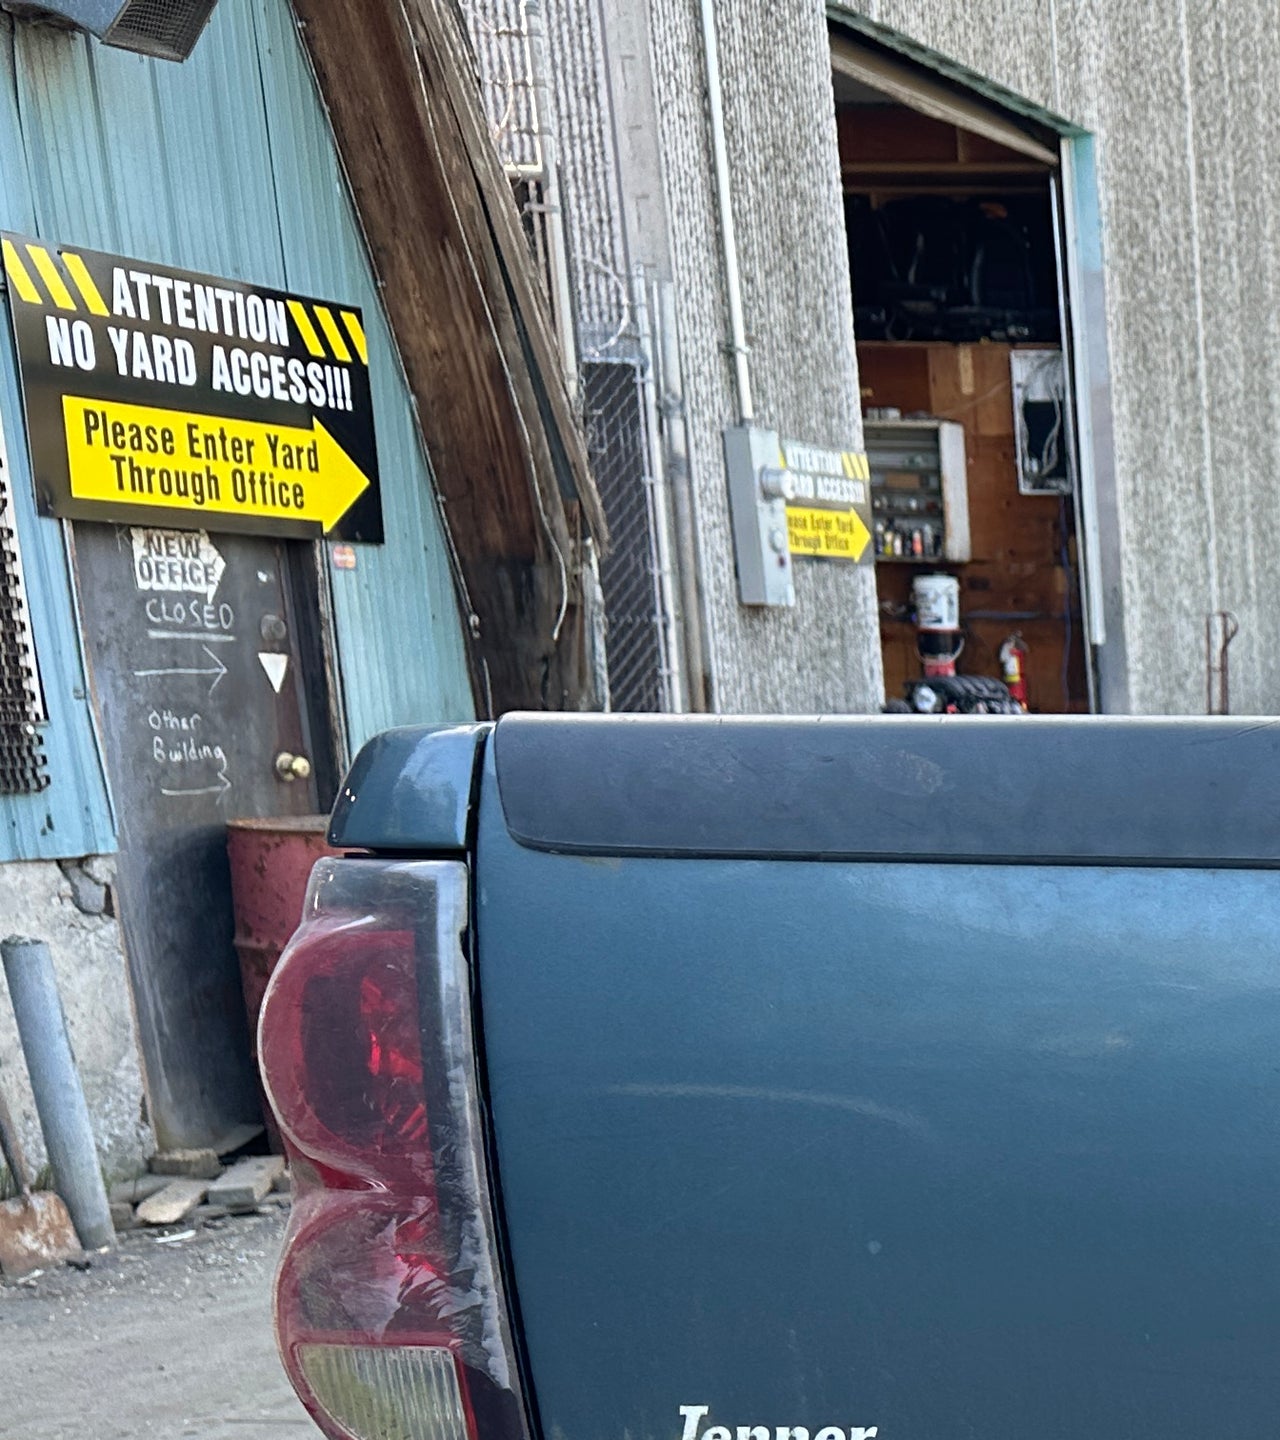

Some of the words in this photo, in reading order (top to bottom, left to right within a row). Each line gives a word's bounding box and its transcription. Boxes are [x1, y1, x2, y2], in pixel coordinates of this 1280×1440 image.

[112, 267, 290, 347] ATTENTION
[46, 315, 96, 371] NO
[107, 326, 197, 386] YARD
[211, 346, 353, 411] ACCESS!!!
[83, 409, 175, 455] Please
[188, 423, 255, 465] Enter
[265, 432, 320, 473] Yard
[785, 444, 844, 476] ATTENTION
[110, 455, 220, 505] Through
[232, 473, 305, 510] Office
[147, 534, 199, 558] NEW
[139, 555, 218, 586] OFFICE
[146, 598, 234, 630] CLOSED
[152, 737, 227, 774] Building
